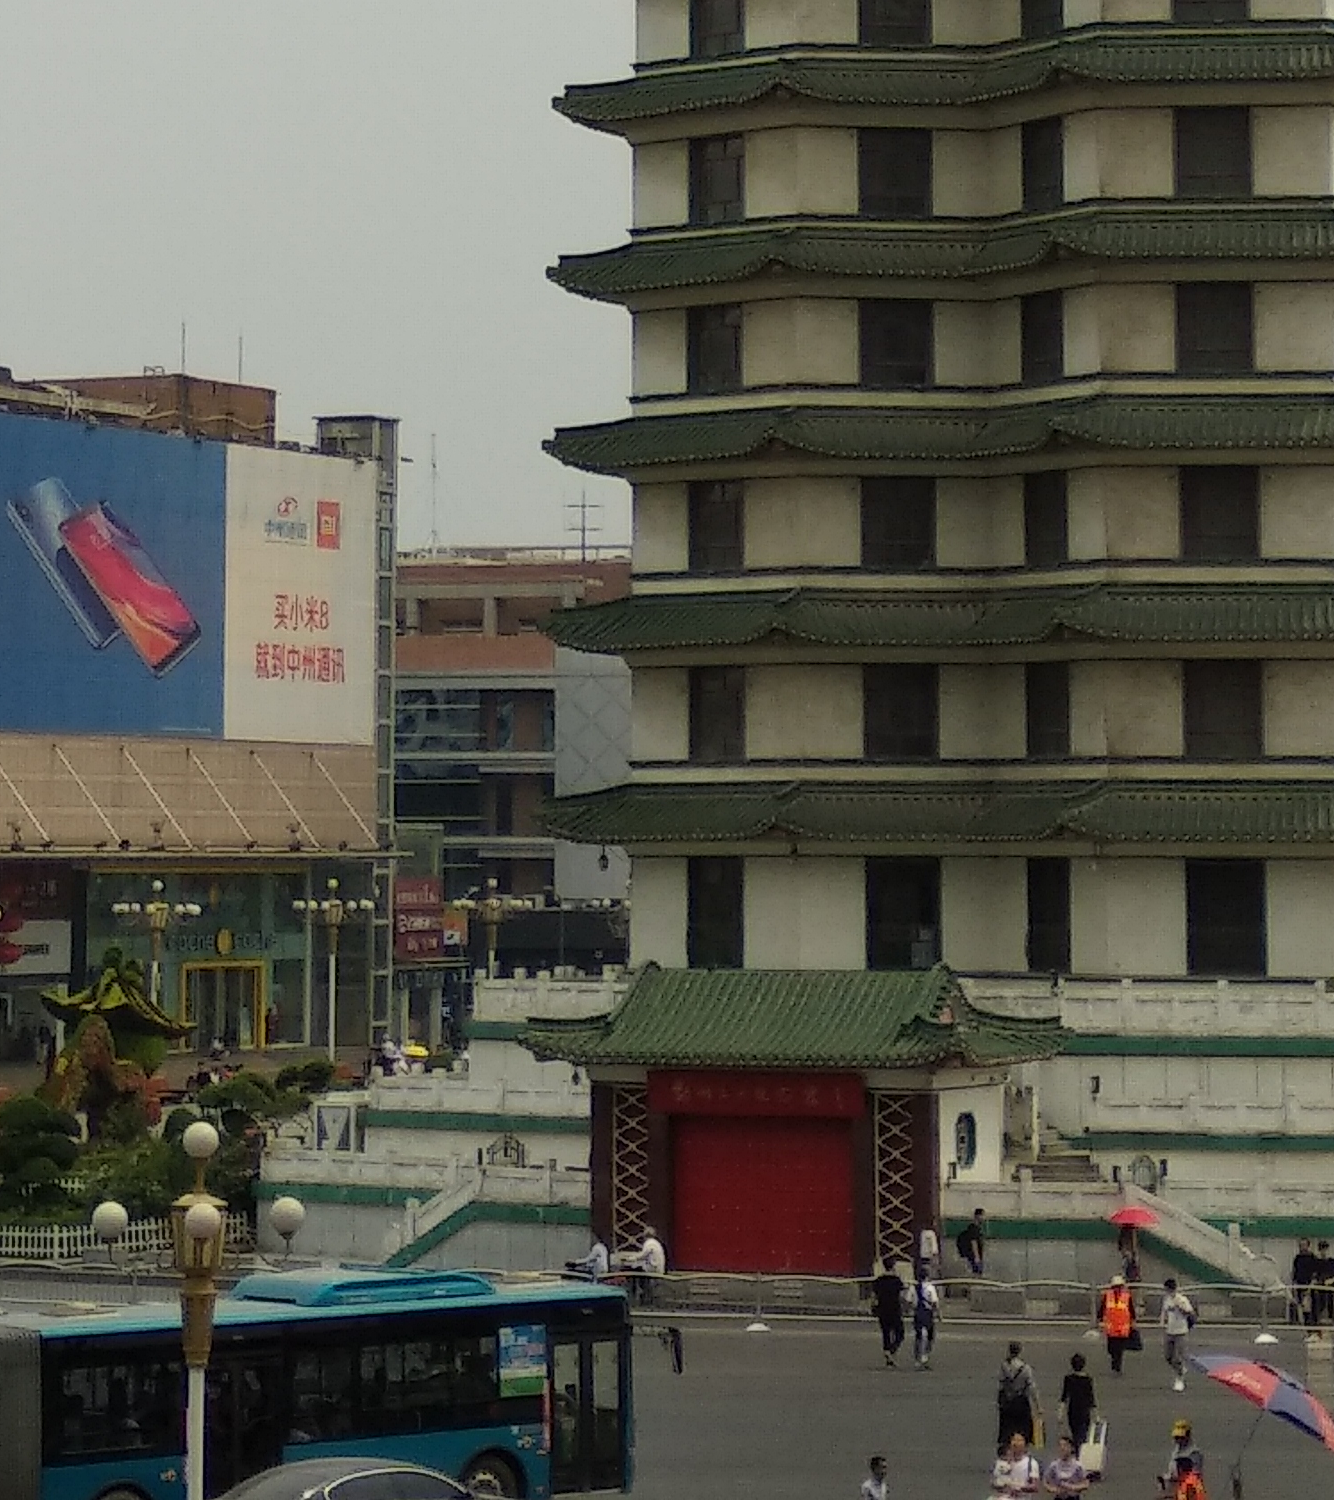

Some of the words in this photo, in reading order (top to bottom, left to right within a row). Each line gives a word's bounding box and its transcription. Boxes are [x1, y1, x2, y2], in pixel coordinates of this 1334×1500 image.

[273, 593, 330, 633] 买小米8
[254, 639, 345, 684] 就到中州通讯
